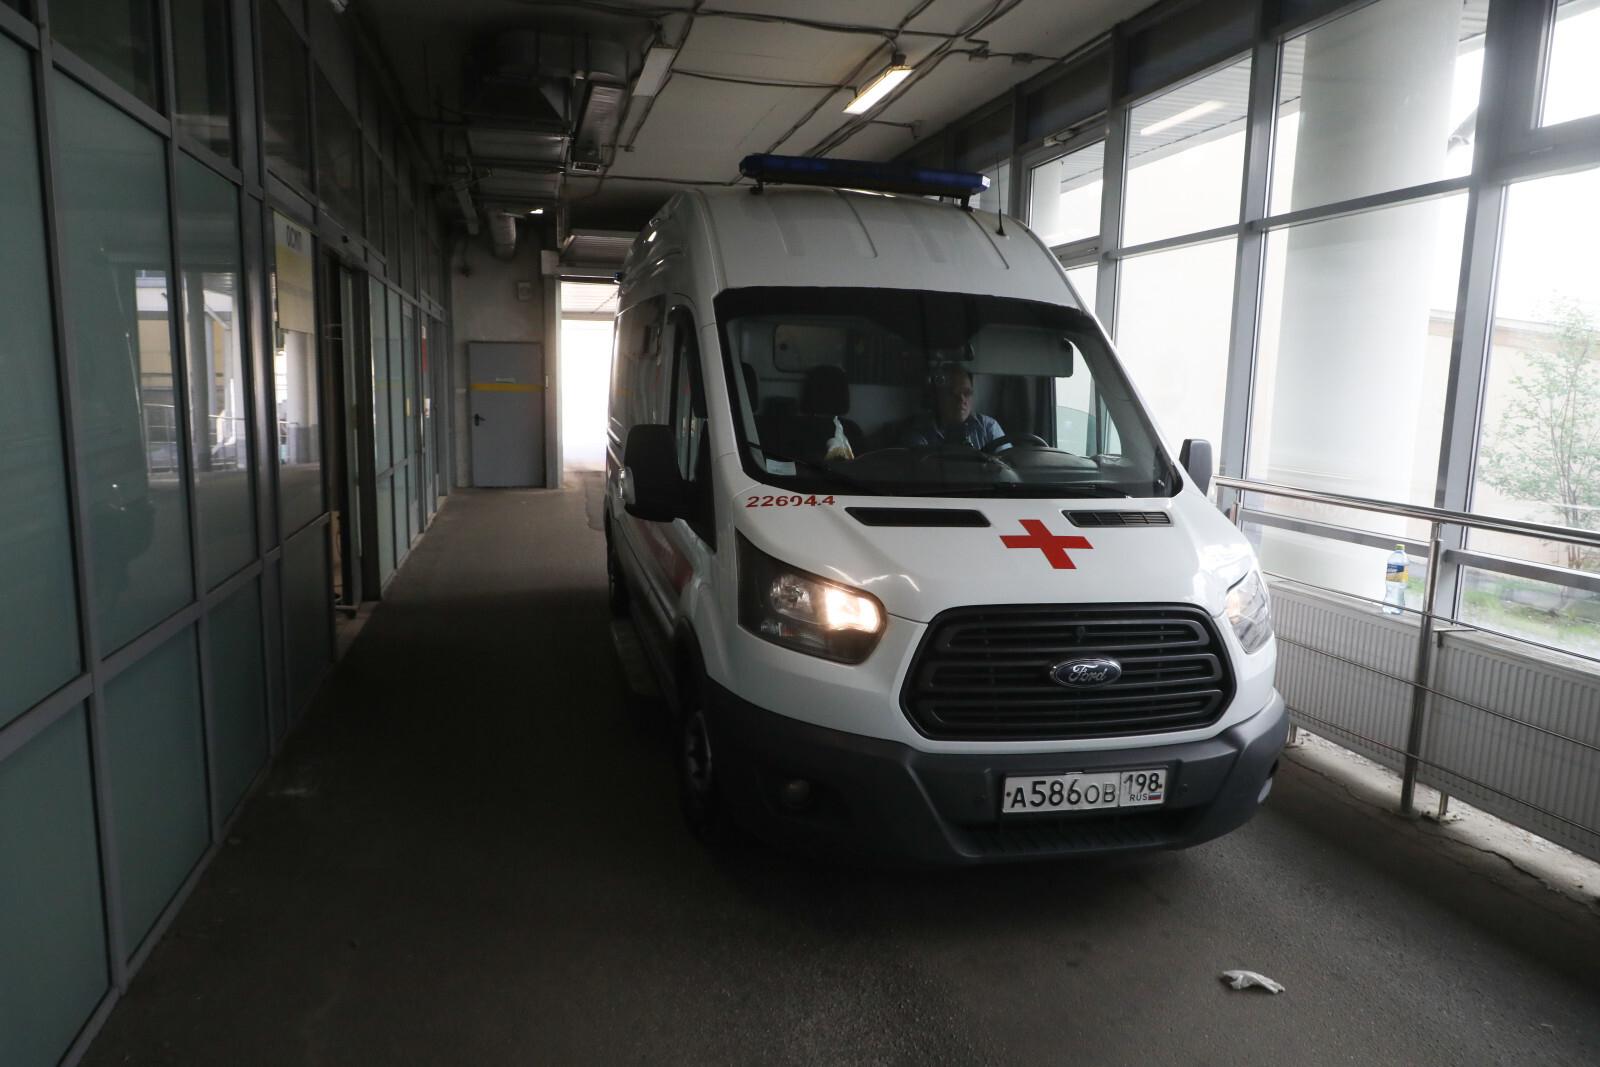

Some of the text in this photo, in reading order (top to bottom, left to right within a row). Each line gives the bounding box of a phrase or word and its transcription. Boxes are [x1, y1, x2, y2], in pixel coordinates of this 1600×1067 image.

[1068, 664, 1108, 681] Ford
[1123, 773, 1160, 794] 198
[1129, 793, 1148, 802] RUS
